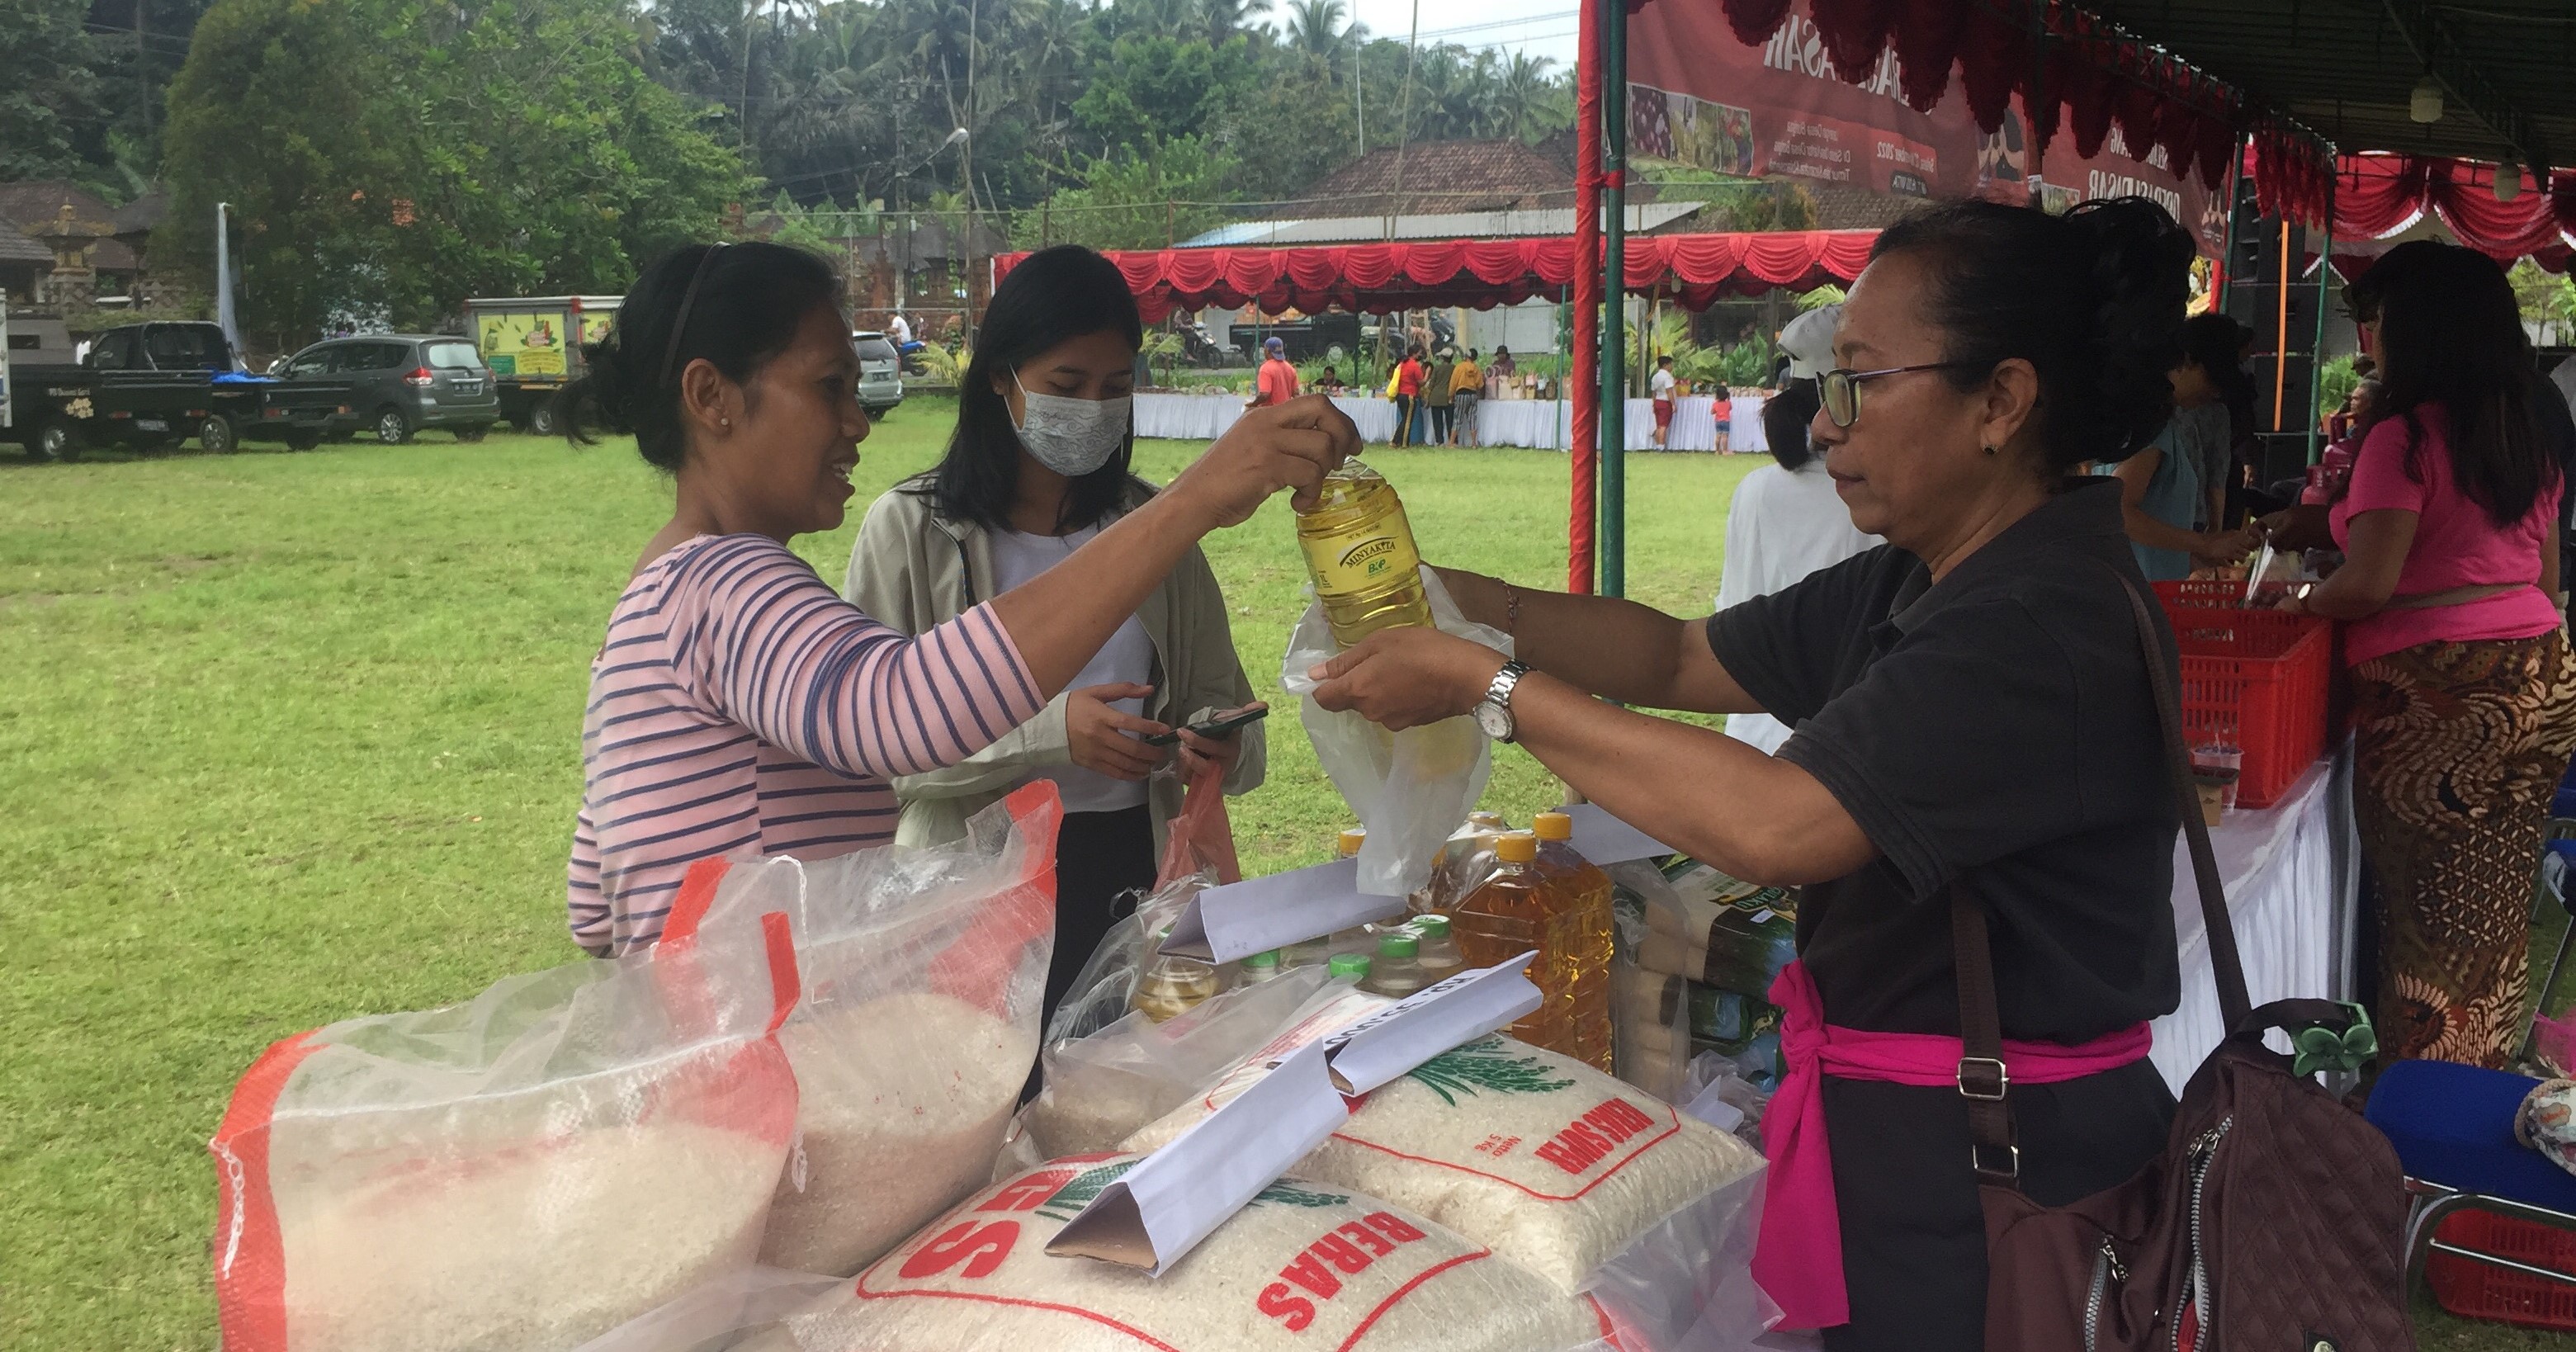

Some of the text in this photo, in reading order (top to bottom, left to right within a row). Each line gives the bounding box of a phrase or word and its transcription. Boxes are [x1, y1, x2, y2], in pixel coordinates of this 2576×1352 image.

[1345, 541, 1397, 569] MINYAKITA
[1534, 1097, 1655, 1175] BERAS SUPER
[1256, 1210, 1428, 1332] BERAS
